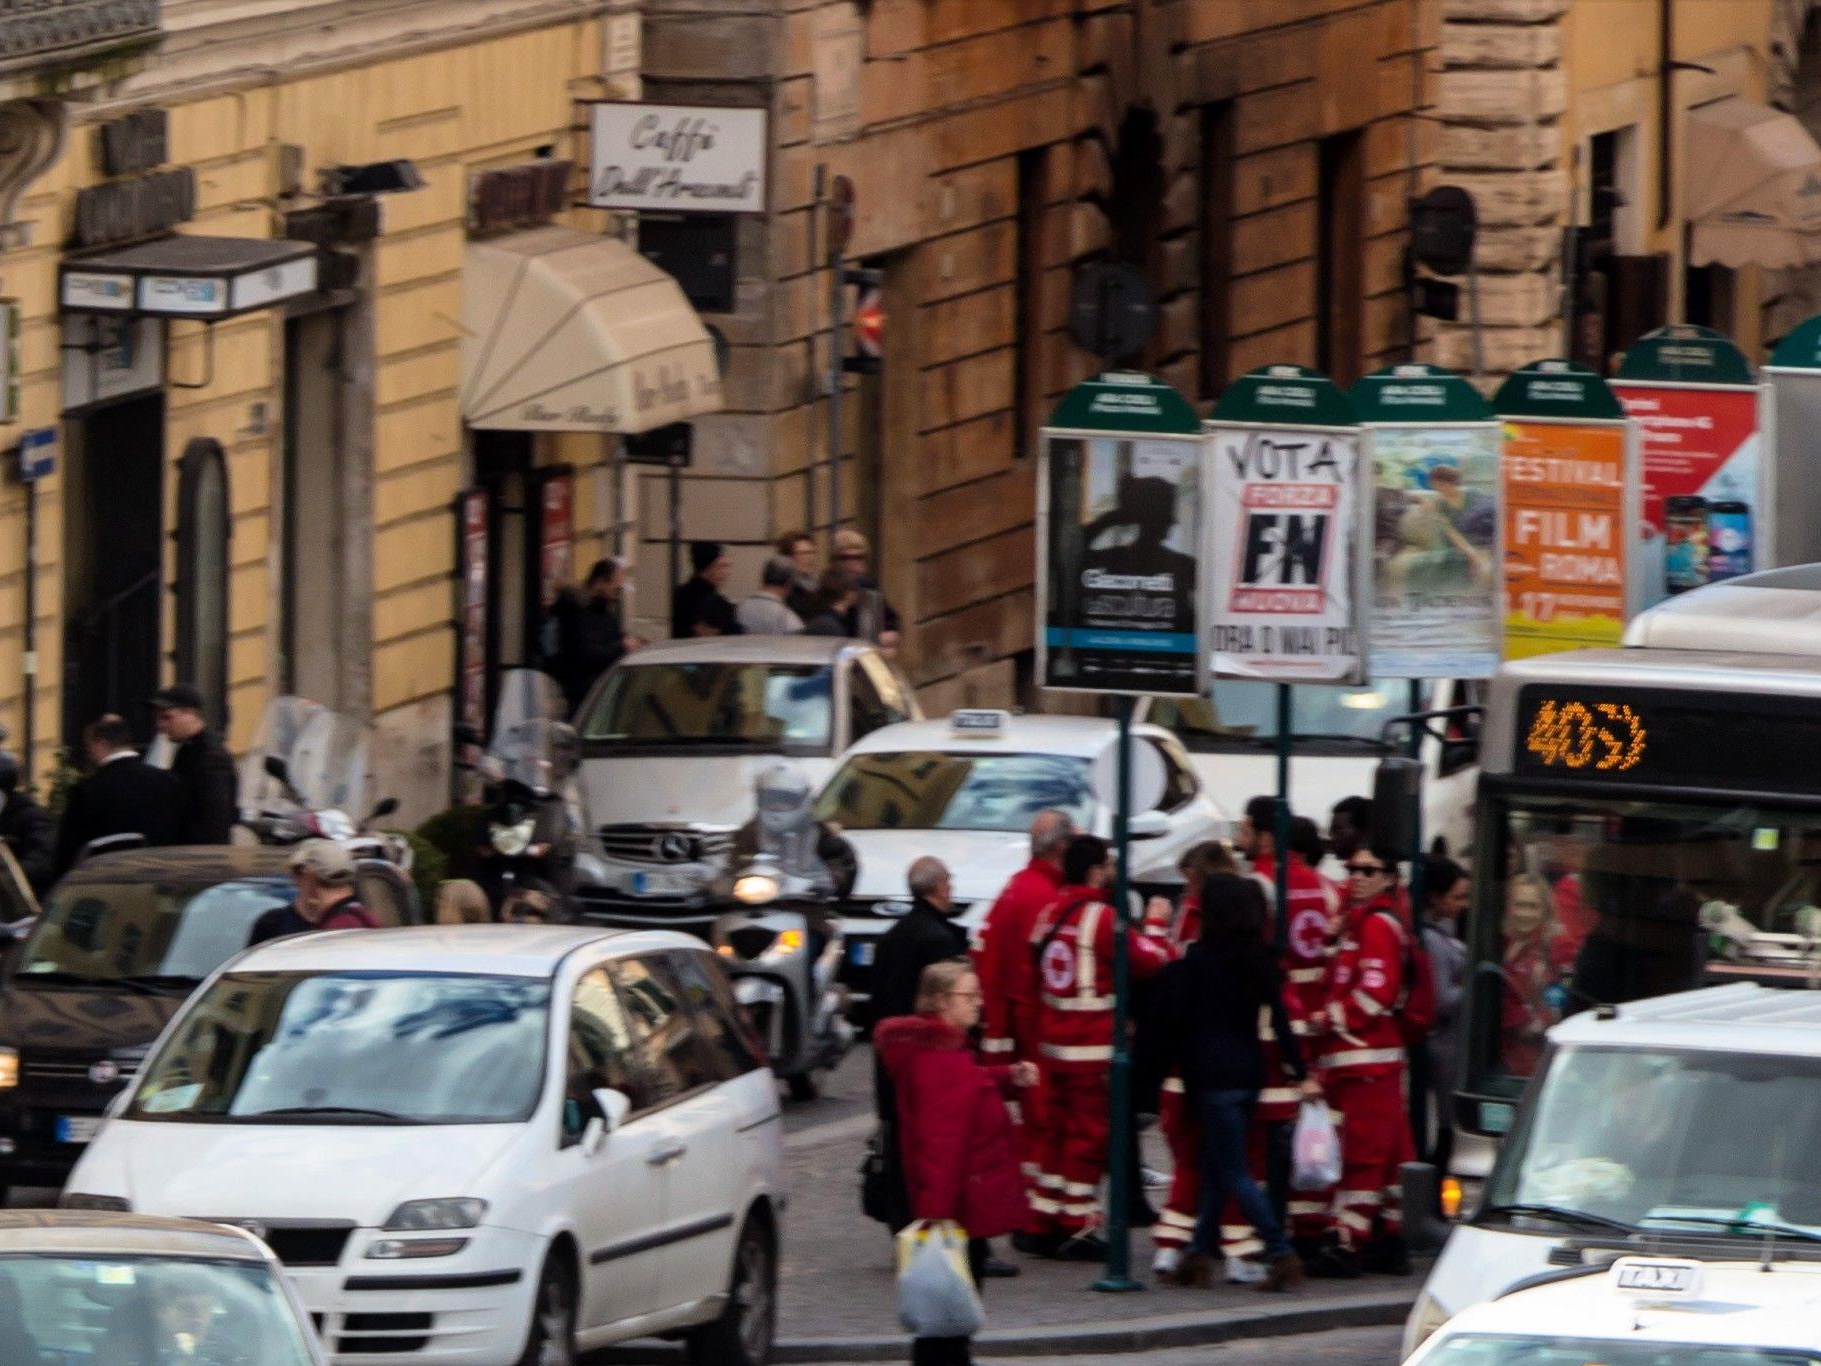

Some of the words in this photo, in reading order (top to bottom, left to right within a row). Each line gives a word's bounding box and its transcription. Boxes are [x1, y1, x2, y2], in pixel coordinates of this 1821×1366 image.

[1226, 433, 1343, 478] VOTA
[1243, 513, 1329, 584] FN
[1515, 510, 1612, 550] FILM
[1540, 552, 1621, 583] ROMA
[1621, 1266, 1689, 1290] TAXI
